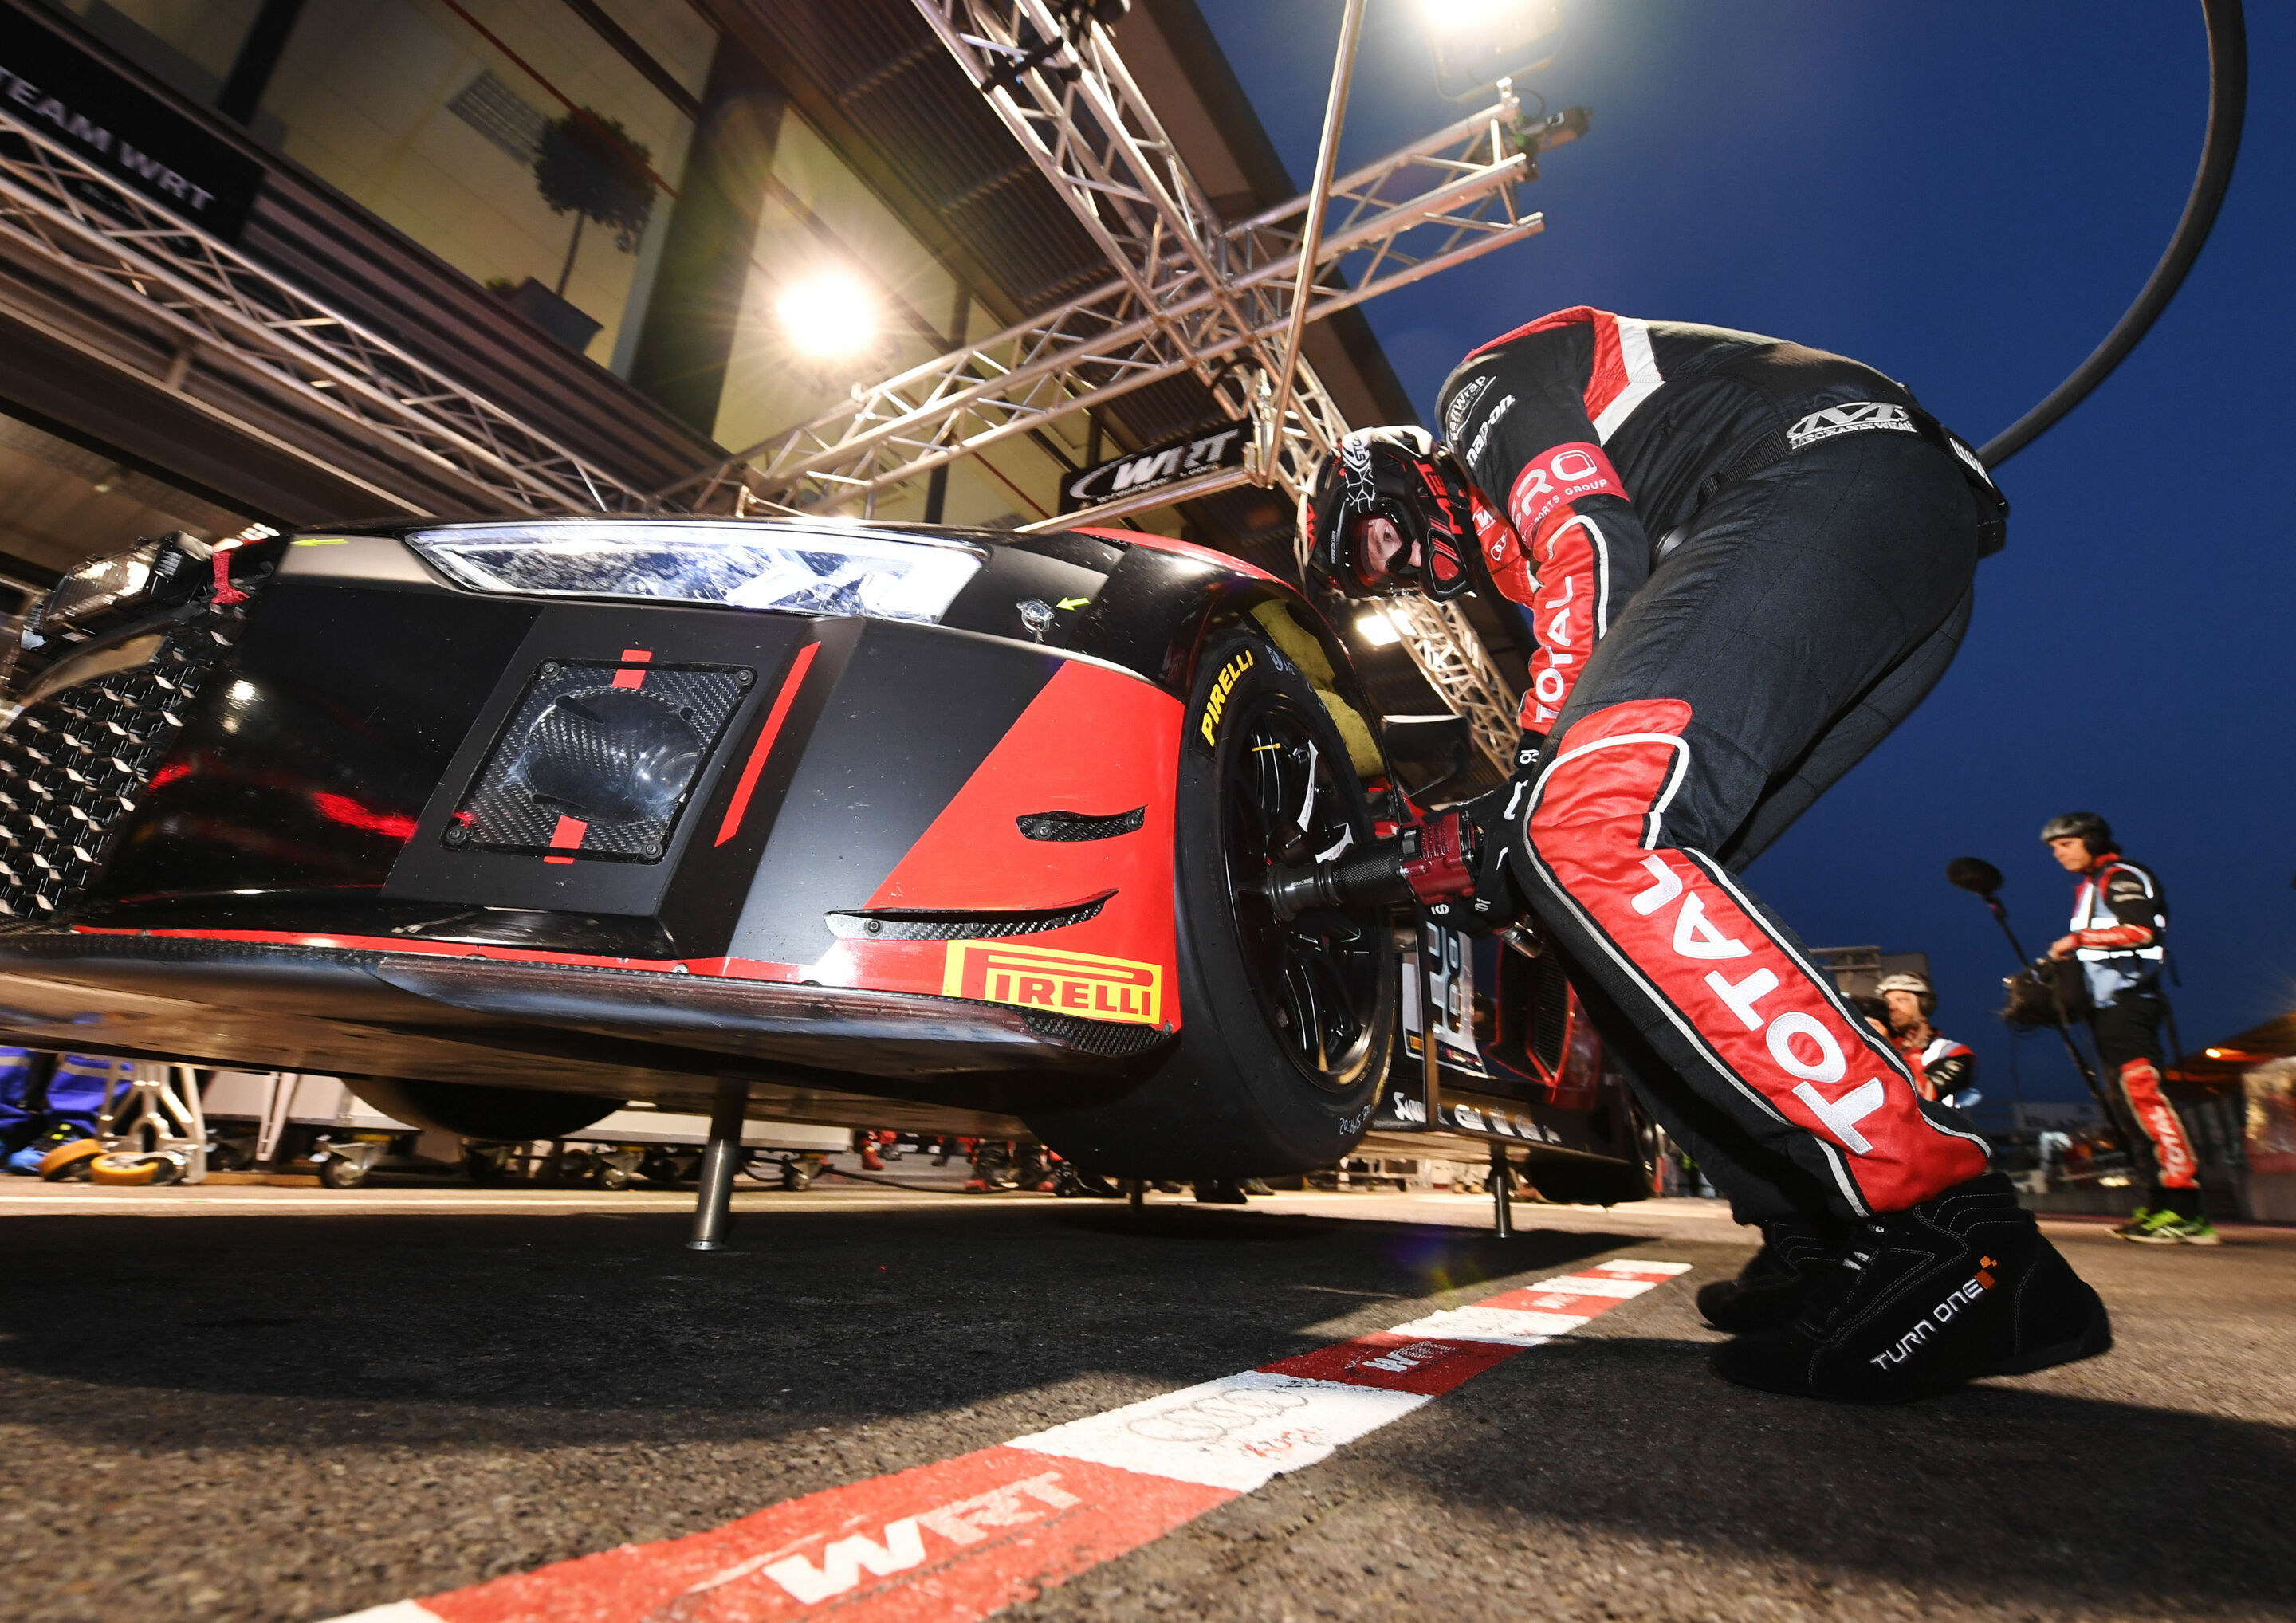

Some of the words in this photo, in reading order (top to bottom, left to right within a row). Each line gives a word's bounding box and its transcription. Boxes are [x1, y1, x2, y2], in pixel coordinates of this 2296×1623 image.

[120, 140, 215, 210] WRT
[1111, 428, 1239, 491] WRT
[1465, 394, 1514, 469] nap-on
[1565, 478, 1608, 496] GROUP
[1531, 576, 1573, 723] TOTAL
[1201, 650, 1254, 747] PIRELLI
[960, 946, 1154, 1016] PIRELLI
[1631, 853, 1885, 1155] TOTAL
[1869, 1318, 1939, 1370] TURN
[1933, 1278, 1984, 1322] ONE
[763, 1470, 1082, 1605] WRT
